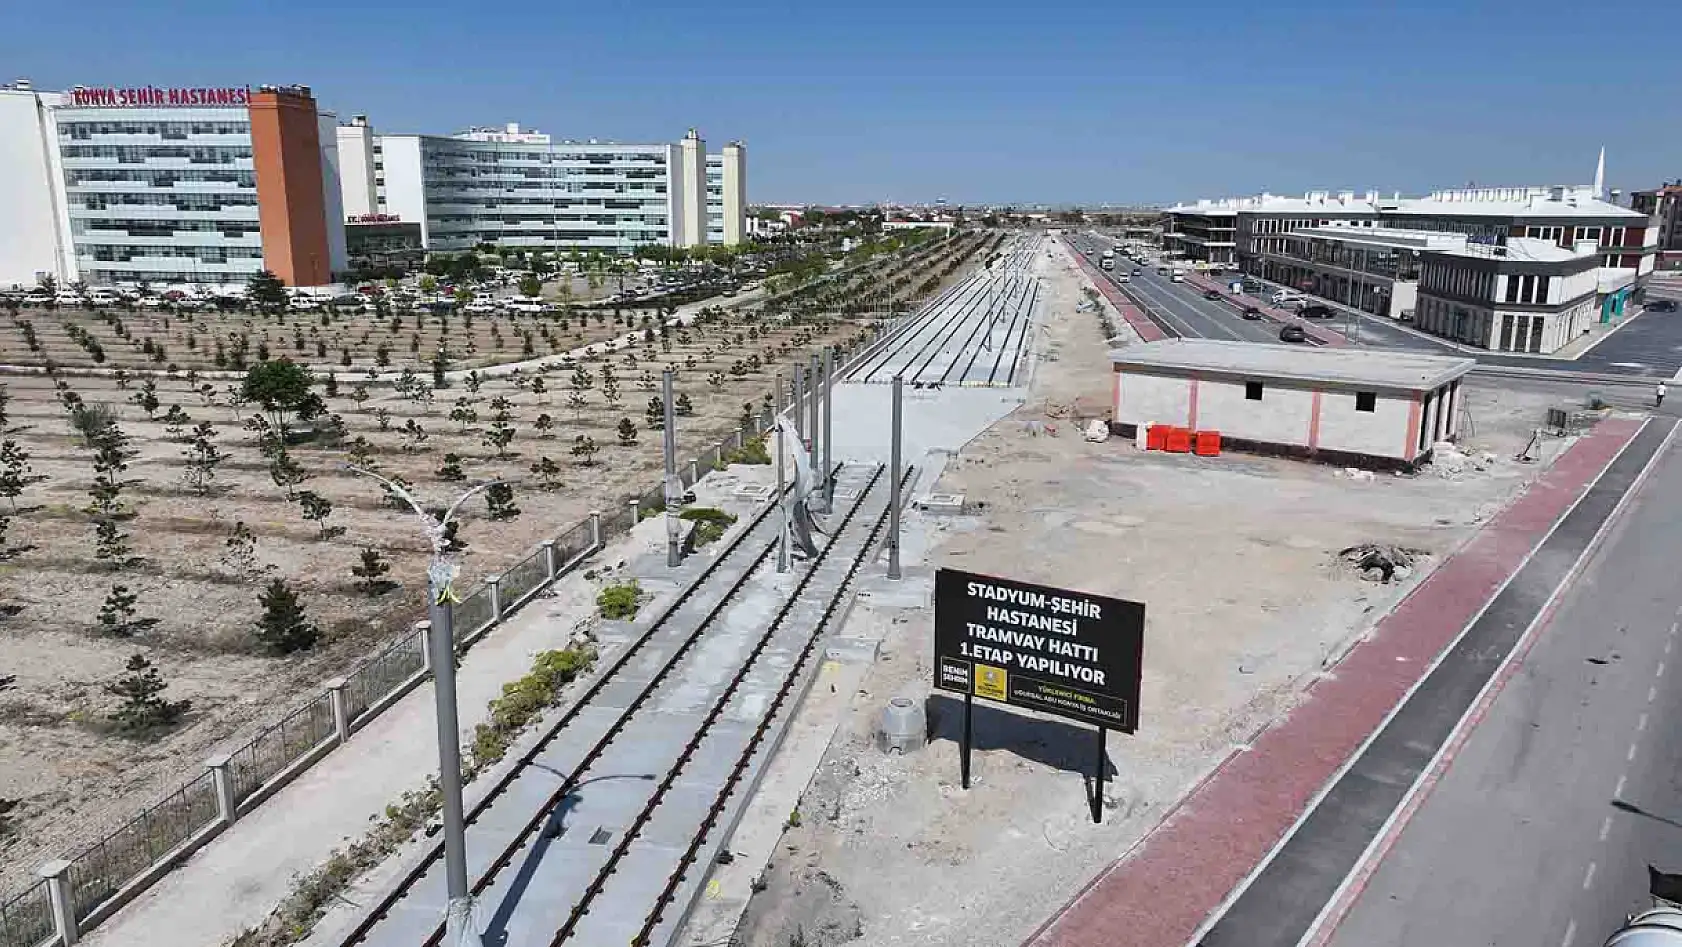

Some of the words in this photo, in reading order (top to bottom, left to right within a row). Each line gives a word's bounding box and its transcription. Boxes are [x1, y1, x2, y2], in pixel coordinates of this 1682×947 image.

[168, 85, 251, 105] HASTANESİ
[967, 581, 1102, 620] STADYUM-ŞEHİR
[987, 606, 1077, 636] HASTANESİ
[966, 622, 1045, 651] TRAMVAY
[1049, 640, 1099, 662] HATTI
[960, 641, 1013, 664] 1.ETAP
[1016, 652, 1106, 686] YAPILIYOR
